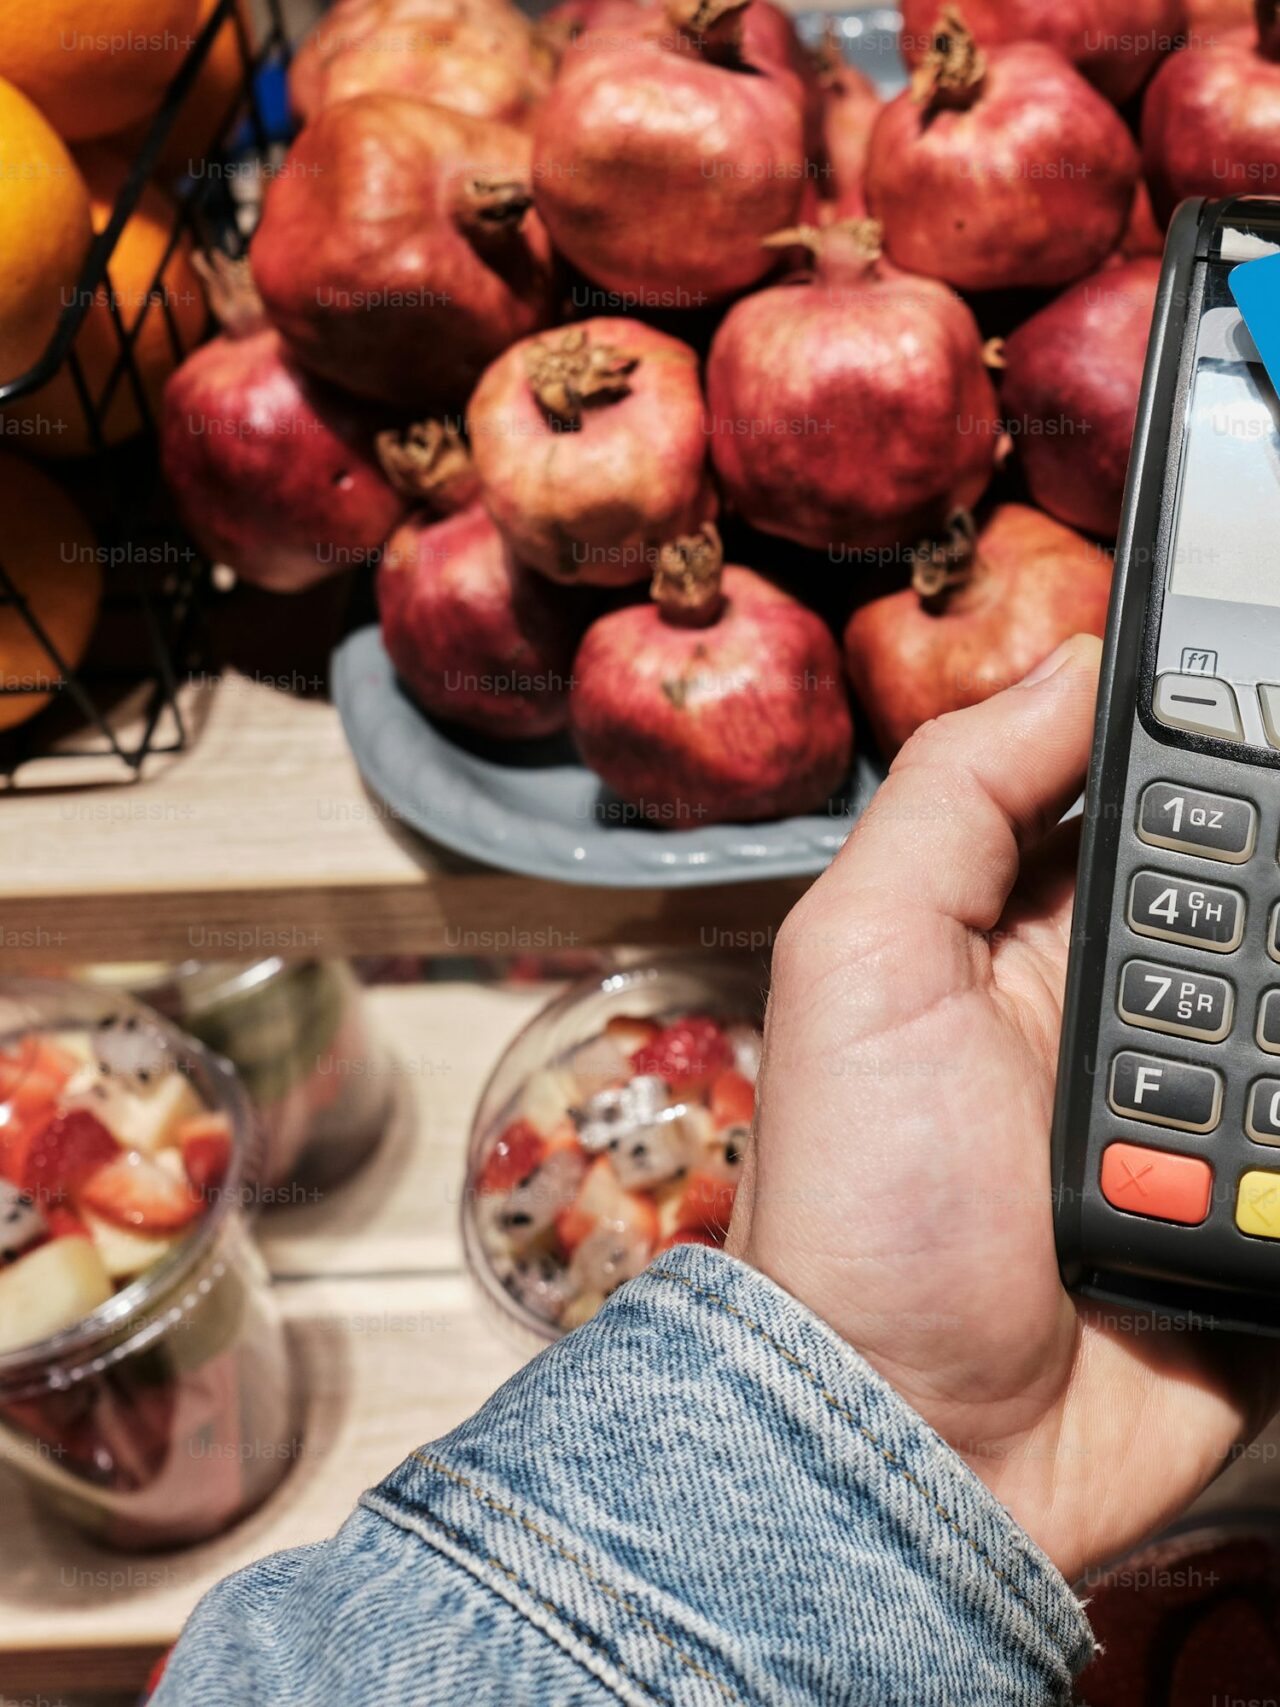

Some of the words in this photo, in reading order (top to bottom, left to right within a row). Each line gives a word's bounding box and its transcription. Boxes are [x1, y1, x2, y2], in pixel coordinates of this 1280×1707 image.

[1187, 652, 1210, 671] f1
[1163, 796, 1184, 832] 1
[1189, 808, 1224, 829] QZ
[1148, 888, 1179, 925] 4
[1144, 975, 1172, 1012] 7
[1134, 1066, 1162, 1104] F
